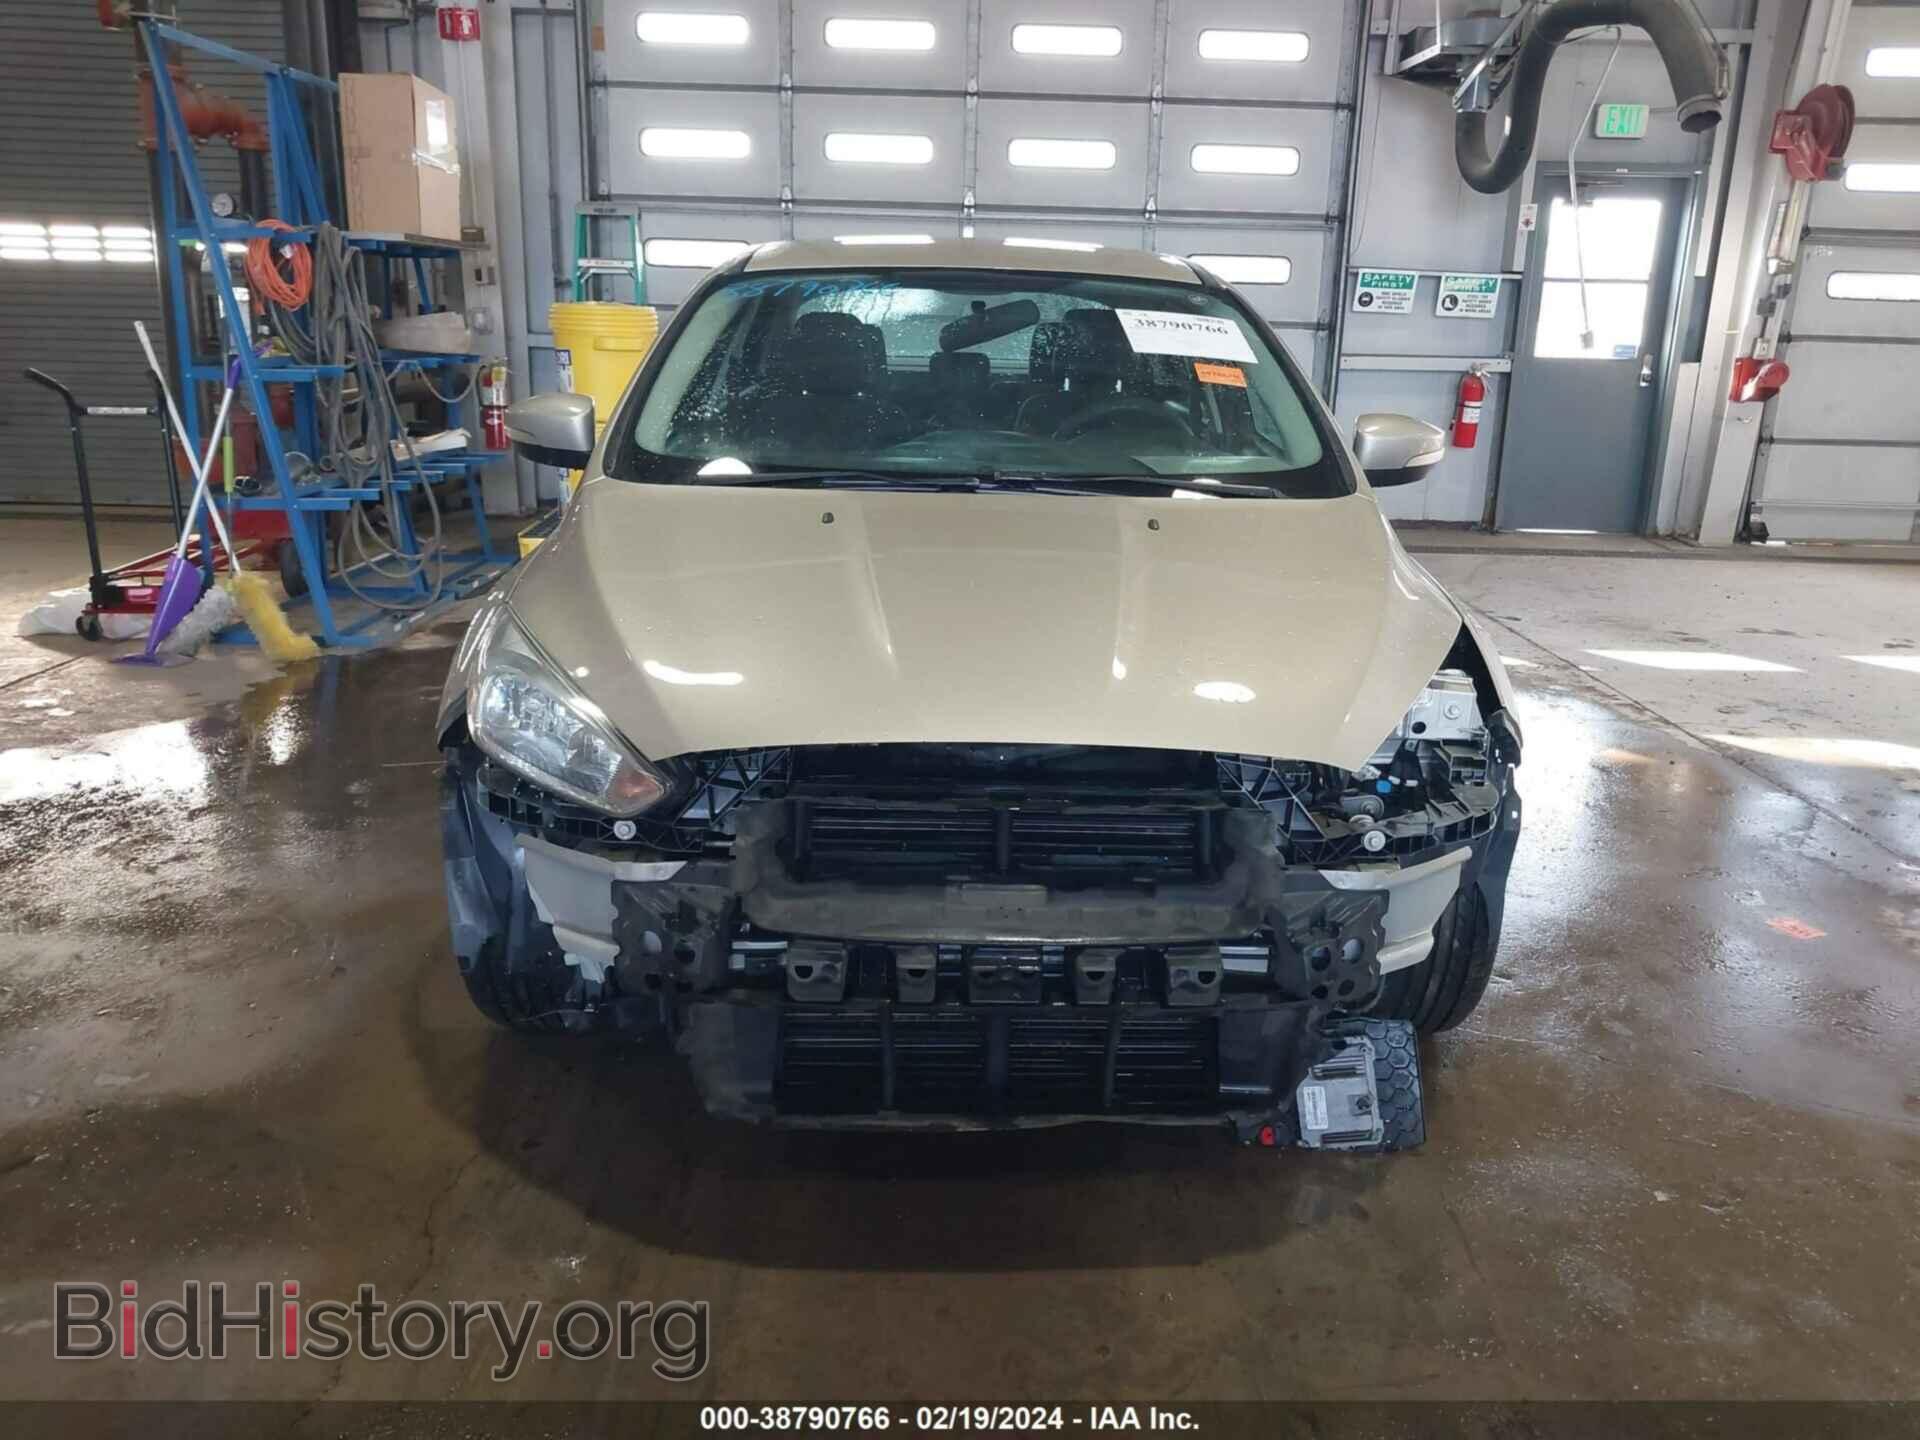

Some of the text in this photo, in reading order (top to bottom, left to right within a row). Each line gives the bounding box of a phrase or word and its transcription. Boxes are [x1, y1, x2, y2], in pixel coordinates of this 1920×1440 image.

[1605, 106, 1643, 134] EXIT
[1364, 274, 1412, 283] SAFETY
[1446, 277, 1496, 288] SAFETY
[1134, 318, 1229, 334] 38790766
